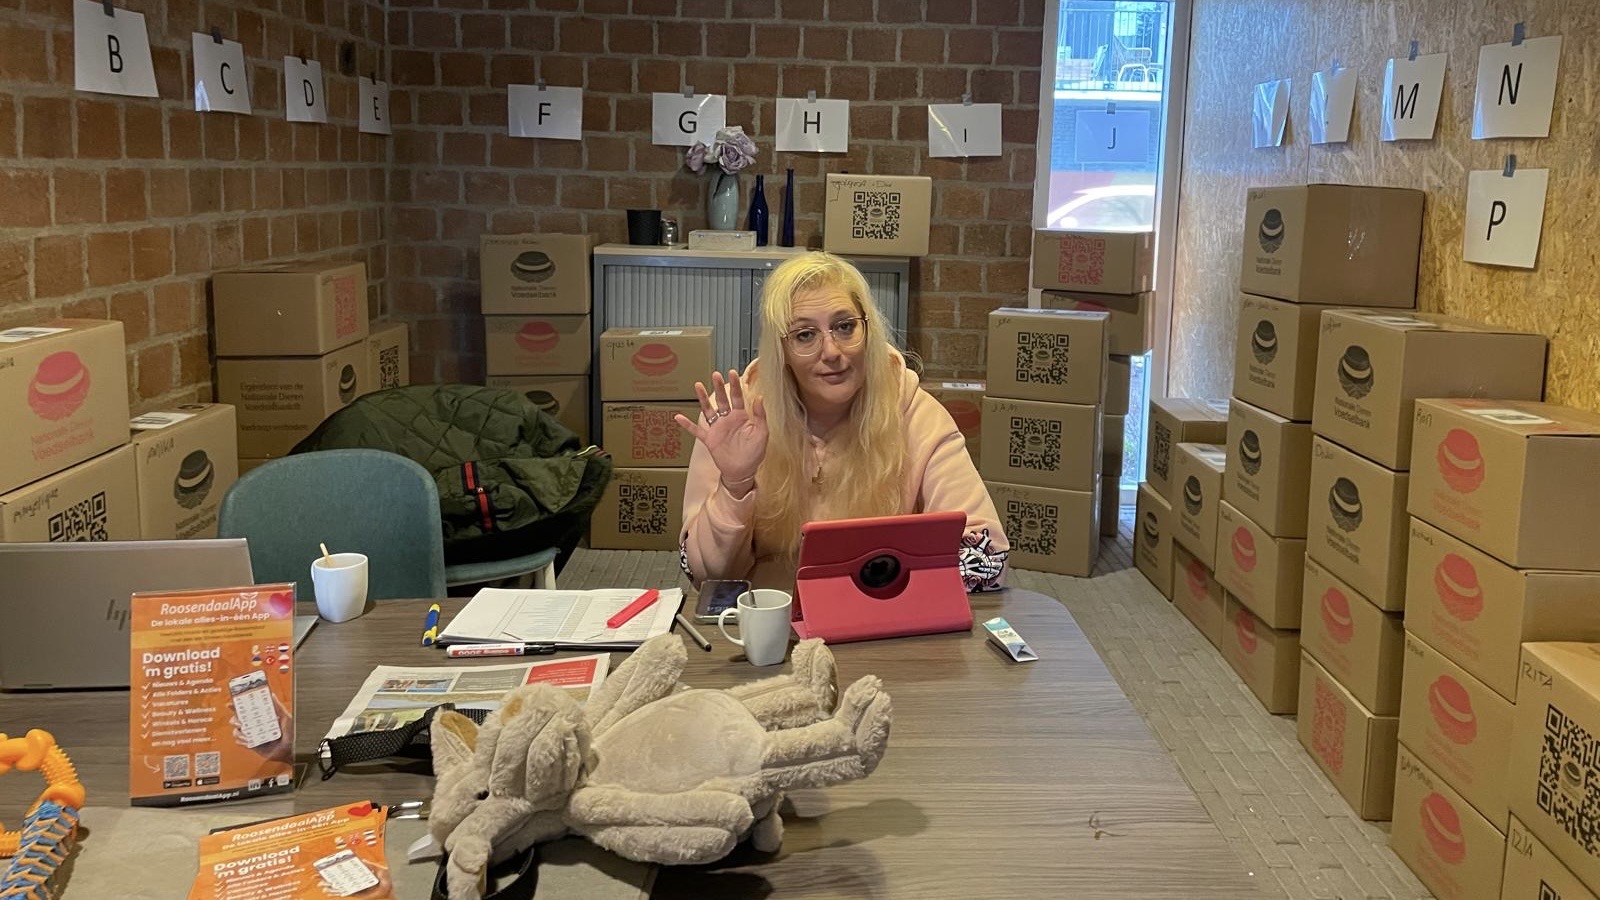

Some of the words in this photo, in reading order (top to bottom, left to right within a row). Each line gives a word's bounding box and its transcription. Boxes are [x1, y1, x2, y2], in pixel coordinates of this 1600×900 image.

[107, 34, 124, 74] B
[219, 62, 235, 95] C
[1497, 62, 1523, 106] N
[302, 78, 315, 107] D
[1393, 82, 1420, 120] M
[373, 96, 382, 121] E
[537, 103, 552, 126] F
[678, 110, 698, 134] G
[803, 111, 822, 135] H
[963, 127, 968, 143] I
[1107, 126, 1117, 150] J
[1486, 200, 1507, 241] P
[160, 597, 257, 616] RoosendaalApp
[151, 619, 163, 627] De
[164, 617, 192, 626] lokale
[252, 612, 271, 621] App
[142, 647, 221, 665] Download
[163, 661, 212, 679] gratis!
[232, 813, 335, 842] RoosendaalApp
[214, 846, 300, 872] Download
[238, 856, 292, 876] gratis!
